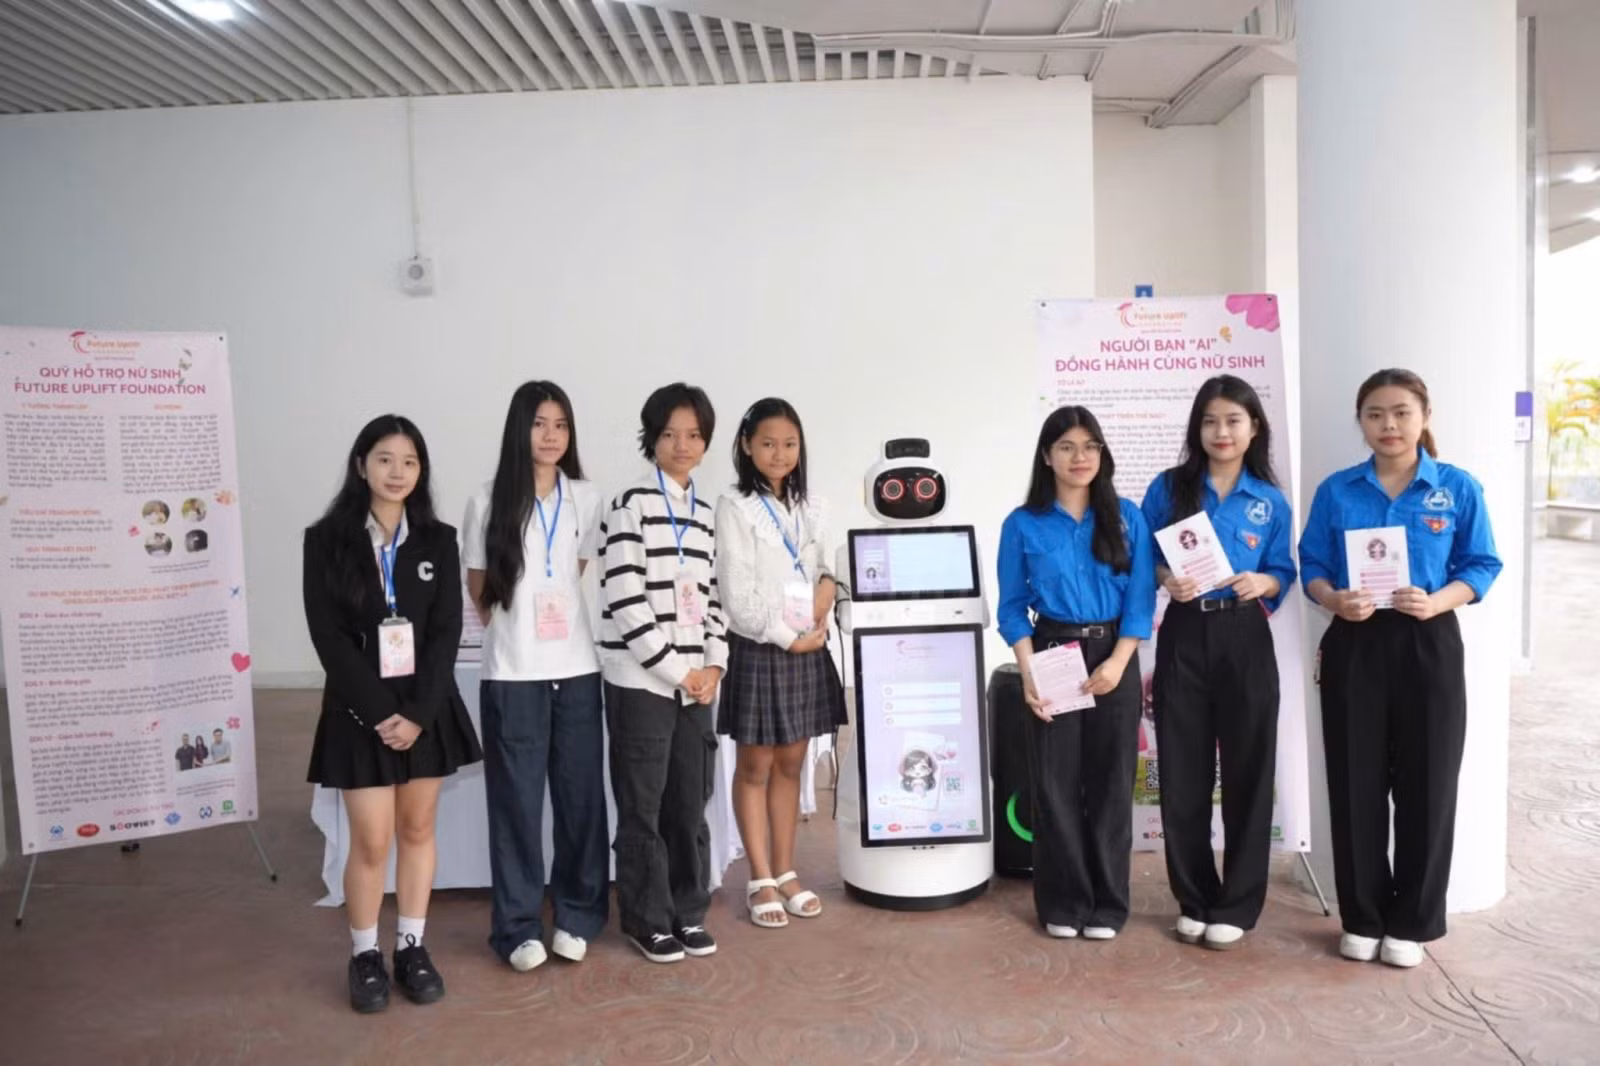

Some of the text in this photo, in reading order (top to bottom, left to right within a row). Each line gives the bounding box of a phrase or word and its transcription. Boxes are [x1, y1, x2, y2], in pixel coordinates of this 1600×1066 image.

[1100, 337, 1150, 352] NGƯỜI
[1154, 339, 1185, 353] BẠN
[1105, 356, 1149, 371] HÀNH
[1201, 353, 1224, 369] NỮ
[1228, 356, 1265, 369] SINH
[150, 368, 182, 379] SINH
[14, 382, 206, 395] FUTURE UPLIFT FOUNDATION
[418, 561, 434, 581] C
